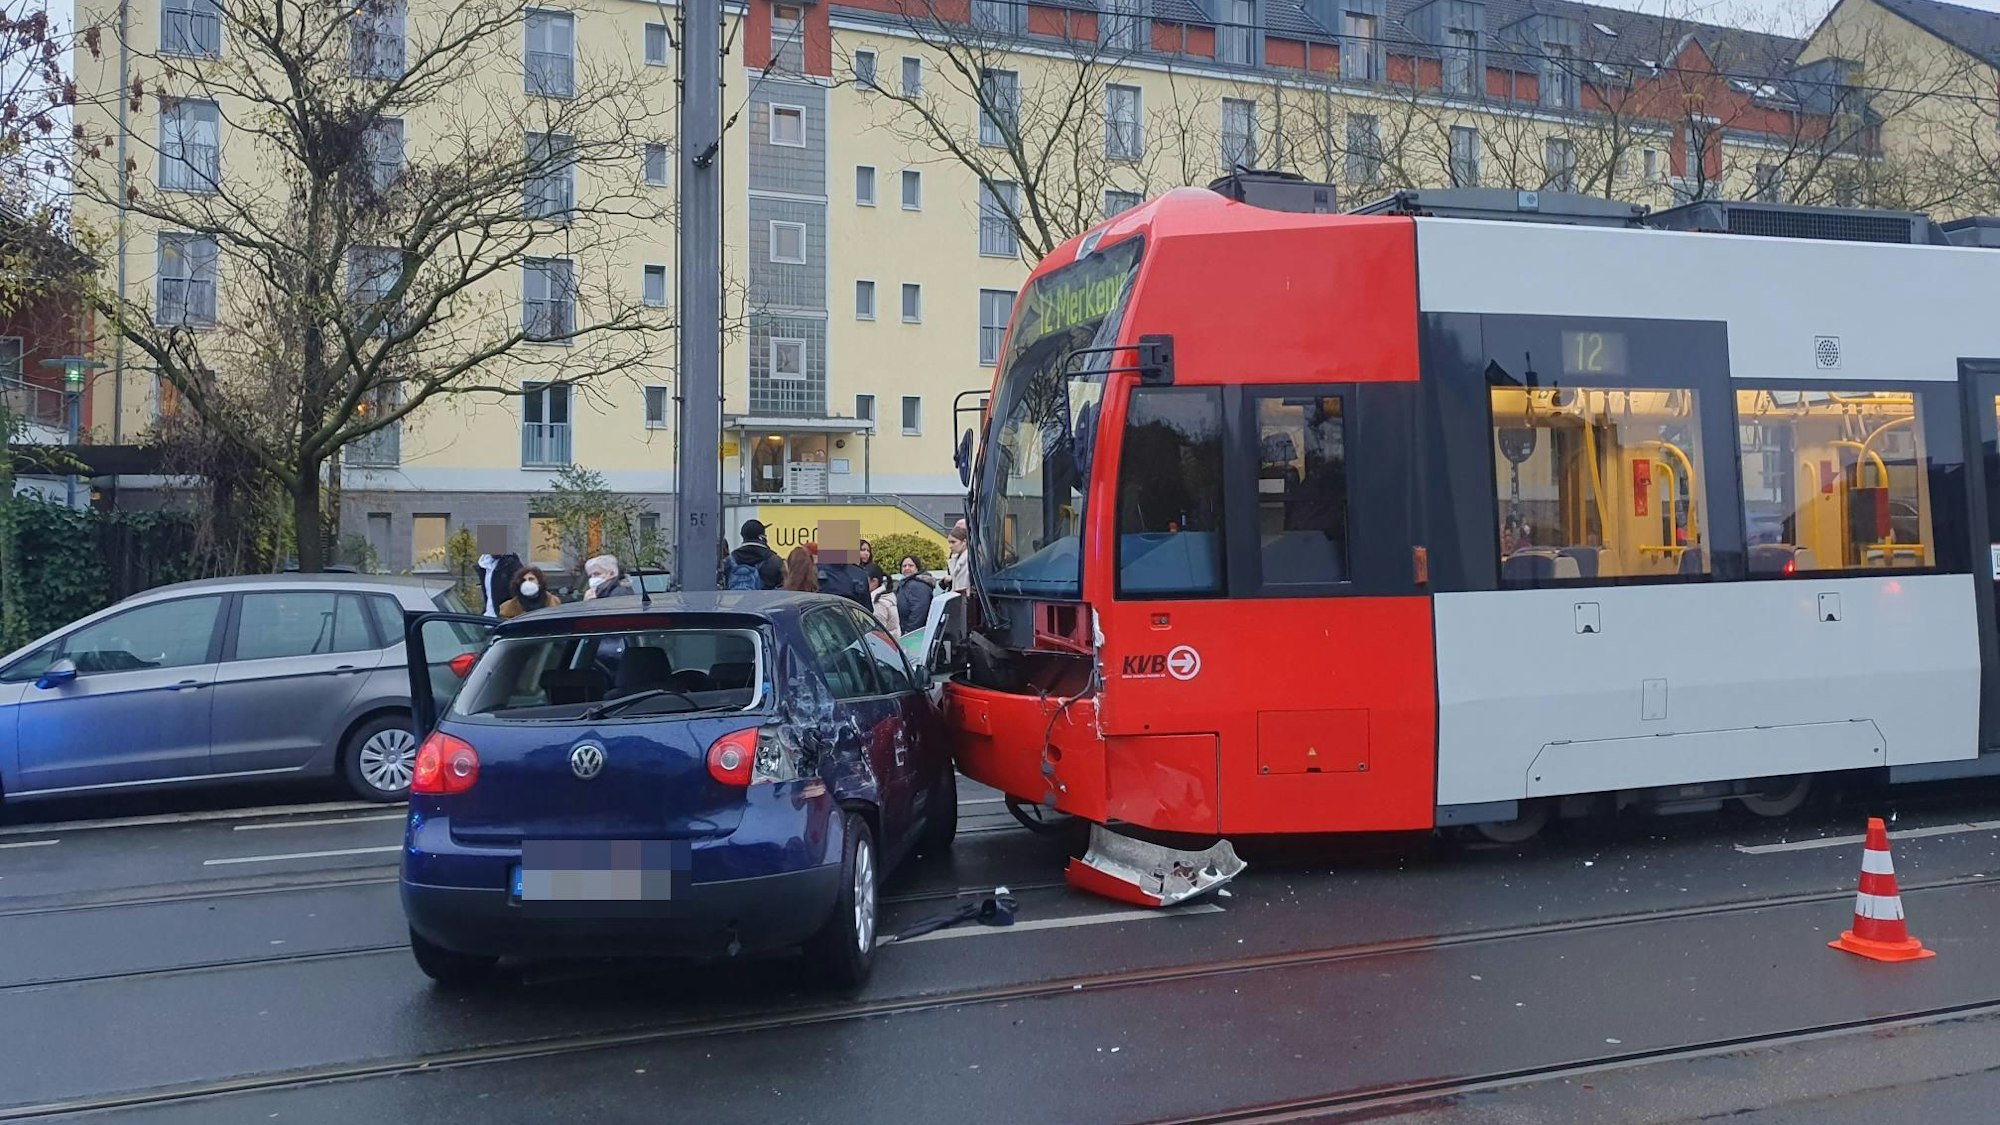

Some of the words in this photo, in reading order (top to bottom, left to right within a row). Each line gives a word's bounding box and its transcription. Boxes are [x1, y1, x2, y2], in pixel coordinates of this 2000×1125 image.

[1039, 288, 1054, 335] 12
[1576, 333, 1603, 371] 12
[1122, 654, 1167, 675] KVB
